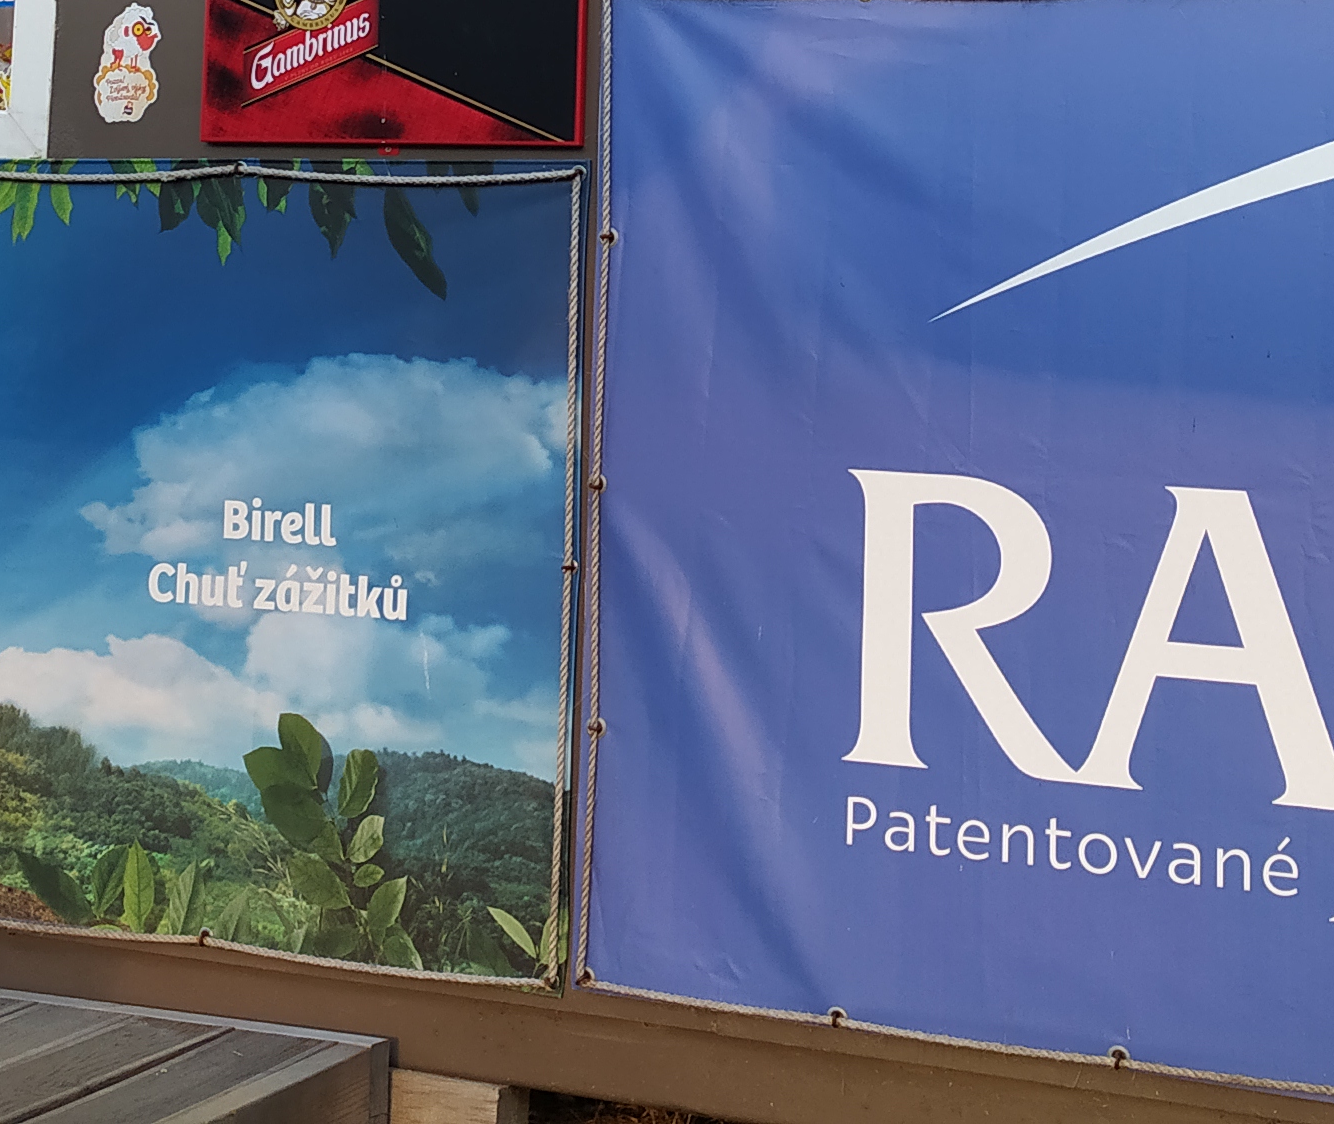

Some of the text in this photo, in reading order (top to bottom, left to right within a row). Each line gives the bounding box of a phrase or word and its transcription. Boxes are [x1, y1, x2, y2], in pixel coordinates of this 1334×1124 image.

[250, 13, 371, 90] Gambrinus
[223, 497, 337, 546] Birell
[148, 560, 408, 621] Chuť zážitků
[845, 795, 1301, 897] Patentované
